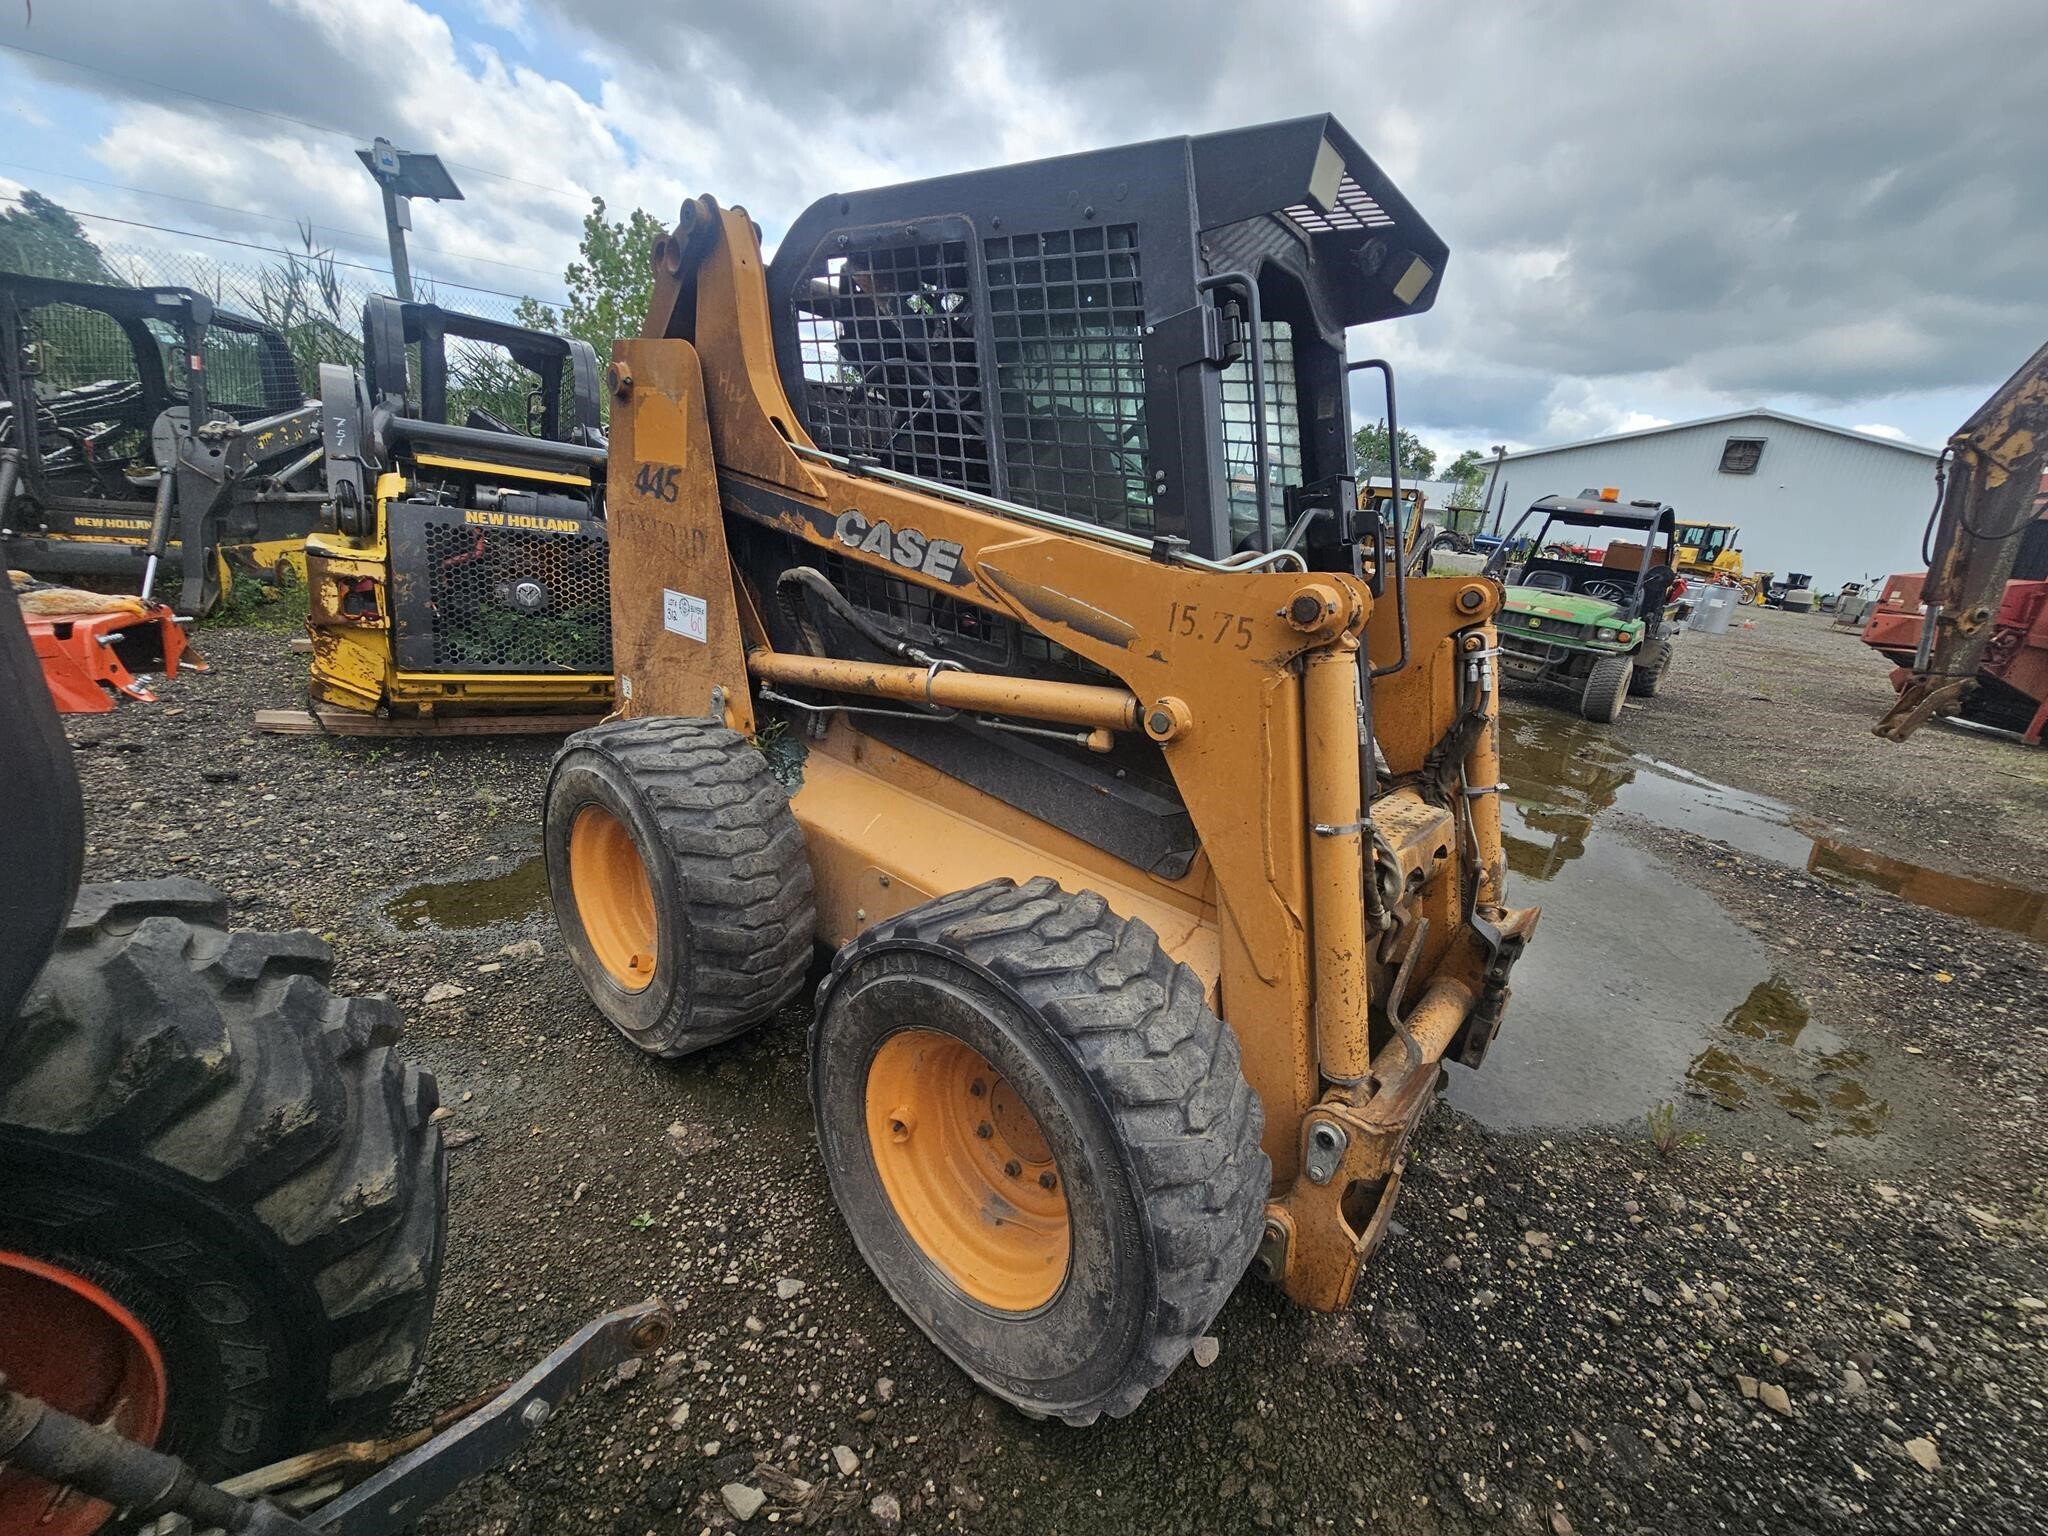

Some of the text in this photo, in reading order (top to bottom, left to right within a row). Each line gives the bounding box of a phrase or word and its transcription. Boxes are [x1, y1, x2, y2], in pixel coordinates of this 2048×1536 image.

[634, 464, 682, 503] 445
[74, 517, 153, 530] NEW HOLLAN
[464, 511, 580, 533] NEW HOLLAND
[836, 510, 963, 582] CASE
[1168, 602, 1254, 651] 15.75
